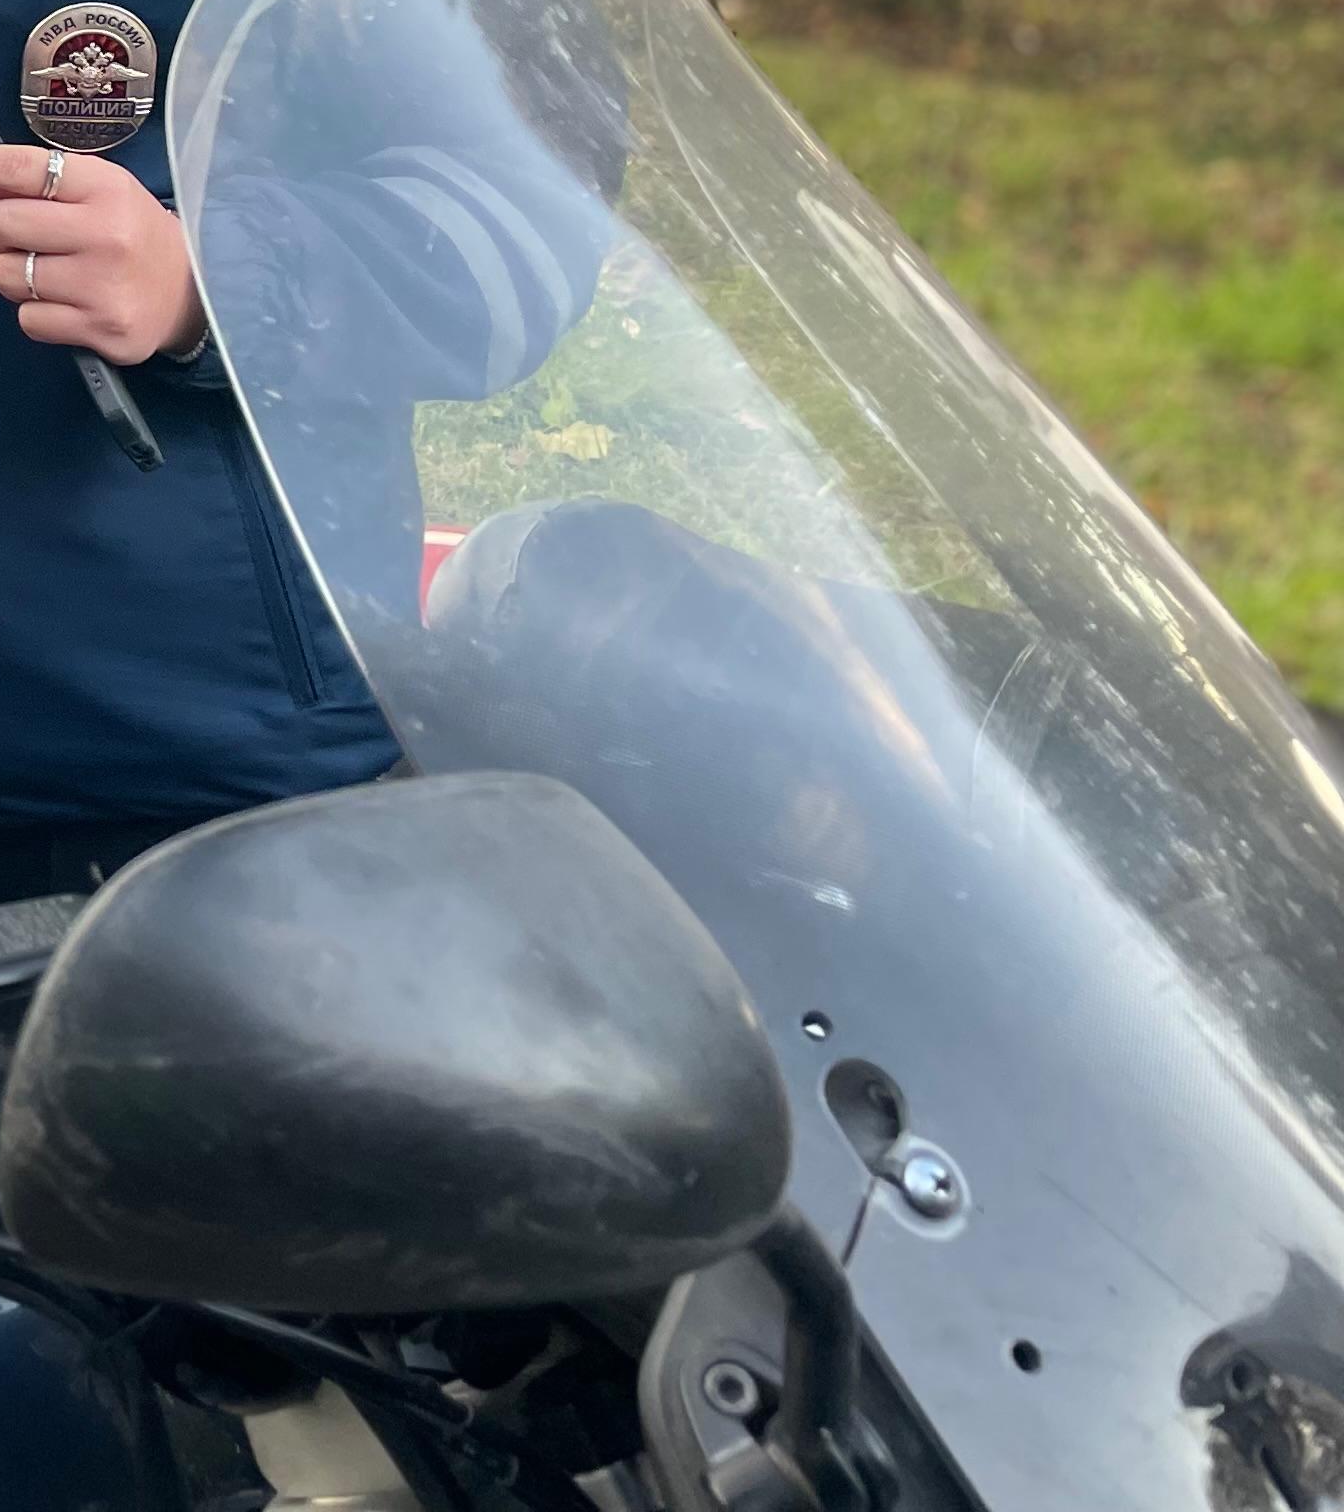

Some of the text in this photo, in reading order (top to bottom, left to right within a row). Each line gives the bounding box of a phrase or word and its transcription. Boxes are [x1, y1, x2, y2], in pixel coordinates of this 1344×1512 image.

[39, 13, 146, 48] МВД РОССИИ
[41, 100, 133, 118] ПОЛИЦИЯ
